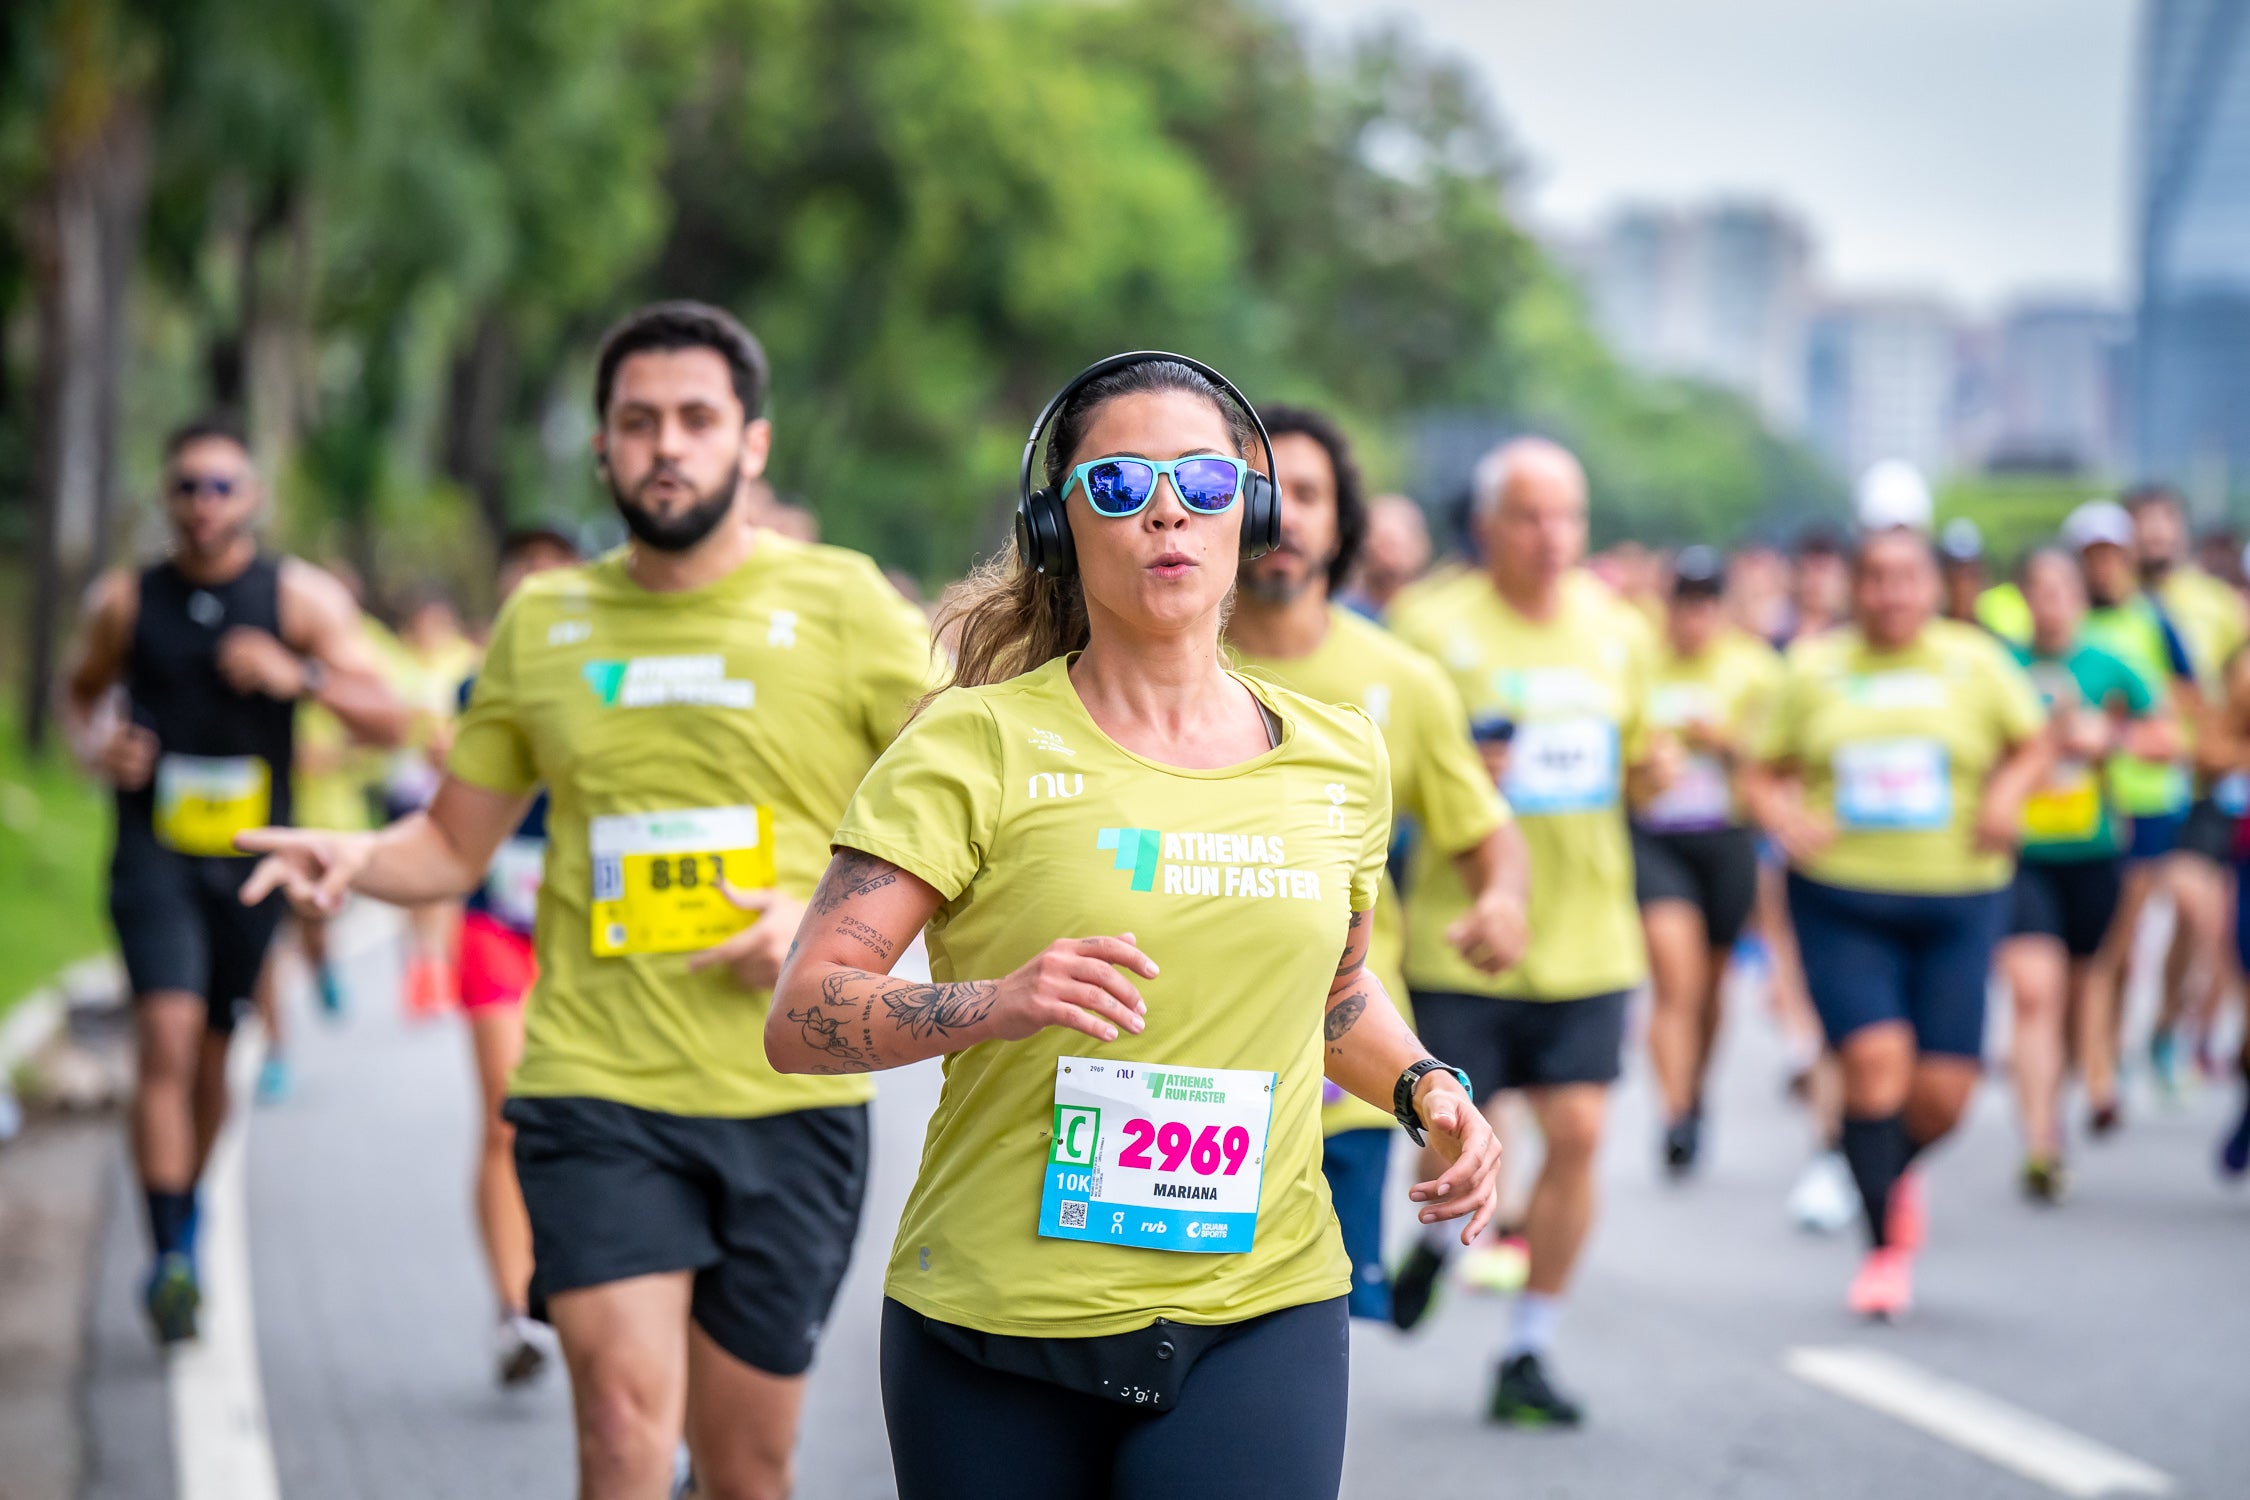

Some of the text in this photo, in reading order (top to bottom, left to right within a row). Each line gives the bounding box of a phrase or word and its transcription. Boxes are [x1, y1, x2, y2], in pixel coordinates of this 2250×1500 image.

[1164, 832, 1286, 865] ATHENAS
[1164, 865, 1322, 900] RUN FASTER
[1089, 1065, 1105, 1073] 2969
[1166, 1073, 1214, 1089] ATHENAS
[1165, 1088, 1226, 1104] RUN FASTER
[1066, 1115, 1087, 1158] C
[1118, 1118, 1250, 1176] 2969
[1056, 1172, 1091, 1193] 10K
[1153, 1183, 1218, 1201] MARIANA
[1200, 1230, 1227, 1239] SPORTS
[1201, 1222, 1228, 1231] IGUANA
